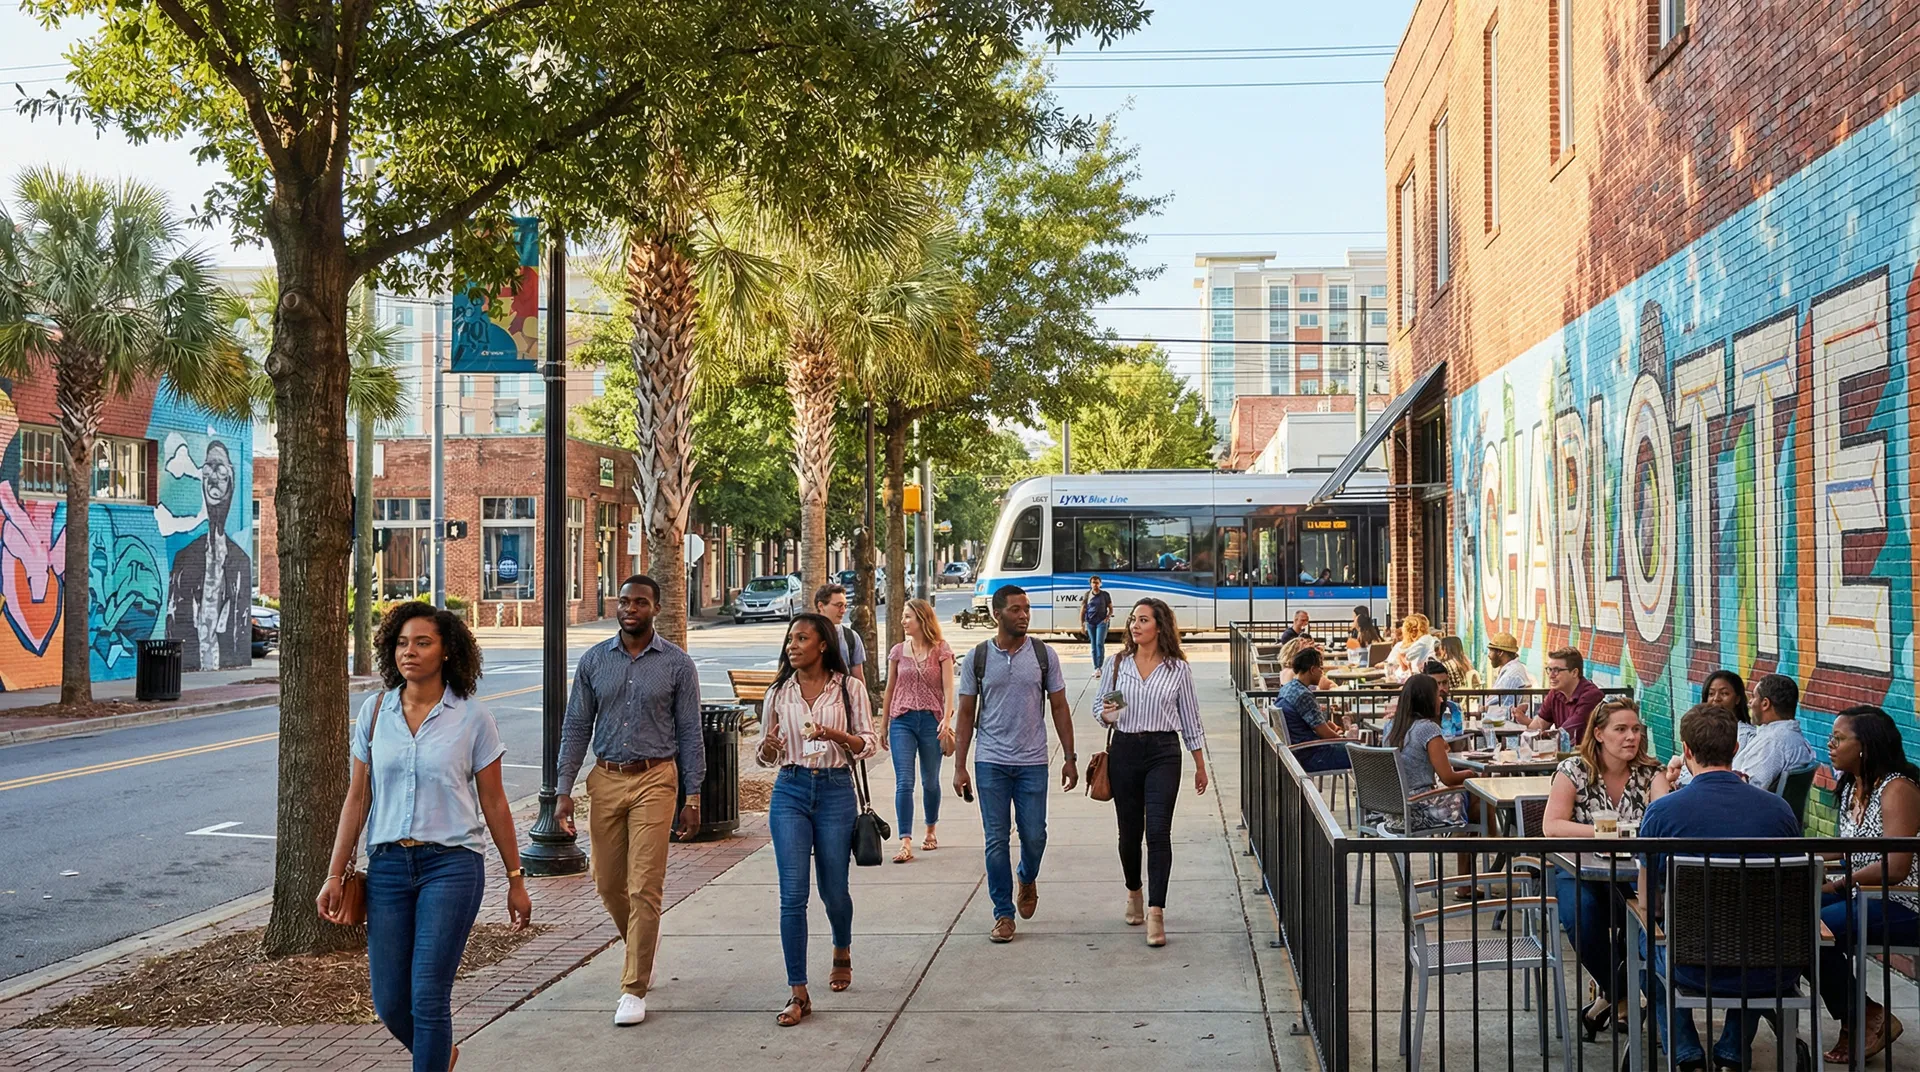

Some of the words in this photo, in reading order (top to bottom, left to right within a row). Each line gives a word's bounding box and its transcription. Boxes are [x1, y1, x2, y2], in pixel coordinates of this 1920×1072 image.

[1059, 495, 1087, 505] LYNX
[1088, 495, 1107, 503] Blue
[1109, 495, 1128, 503] Line
[1480, 265, 1892, 677] CHARLOTTE
